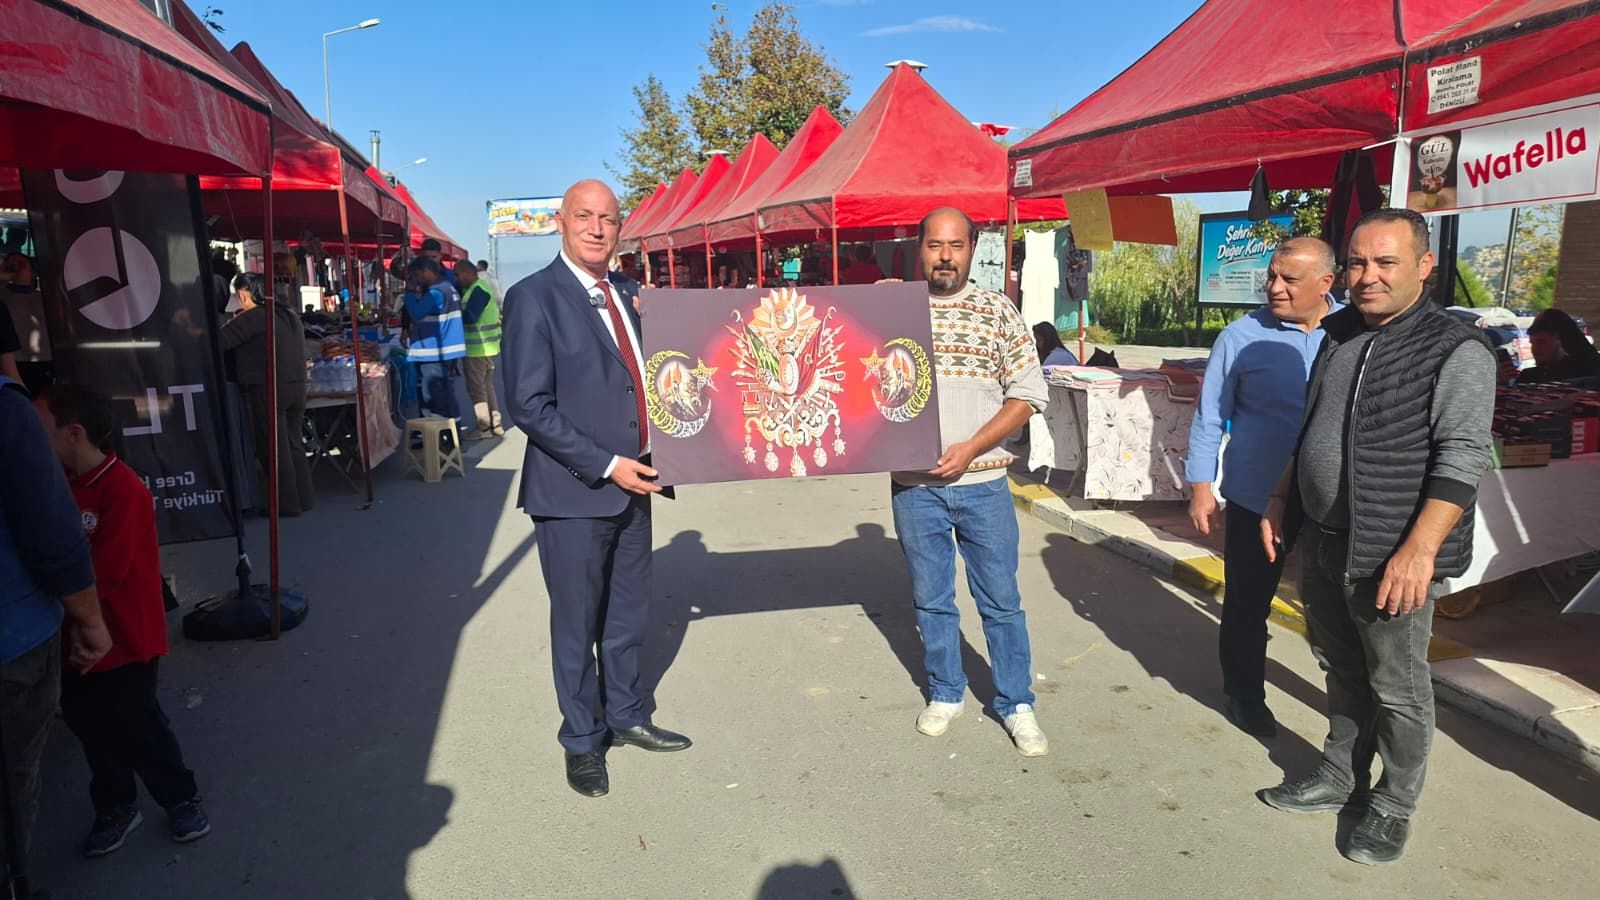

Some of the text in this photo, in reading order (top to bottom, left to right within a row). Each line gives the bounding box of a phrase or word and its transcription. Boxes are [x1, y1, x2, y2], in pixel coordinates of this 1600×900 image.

[1431, 59, 1478, 77] Polat Stand
[1437, 72, 1473, 86] Kiralama
[1421, 140, 1449, 156] GÜL
[1463, 127, 1587, 188] Wafella
[1225, 224, 1253, 244] Şehri
